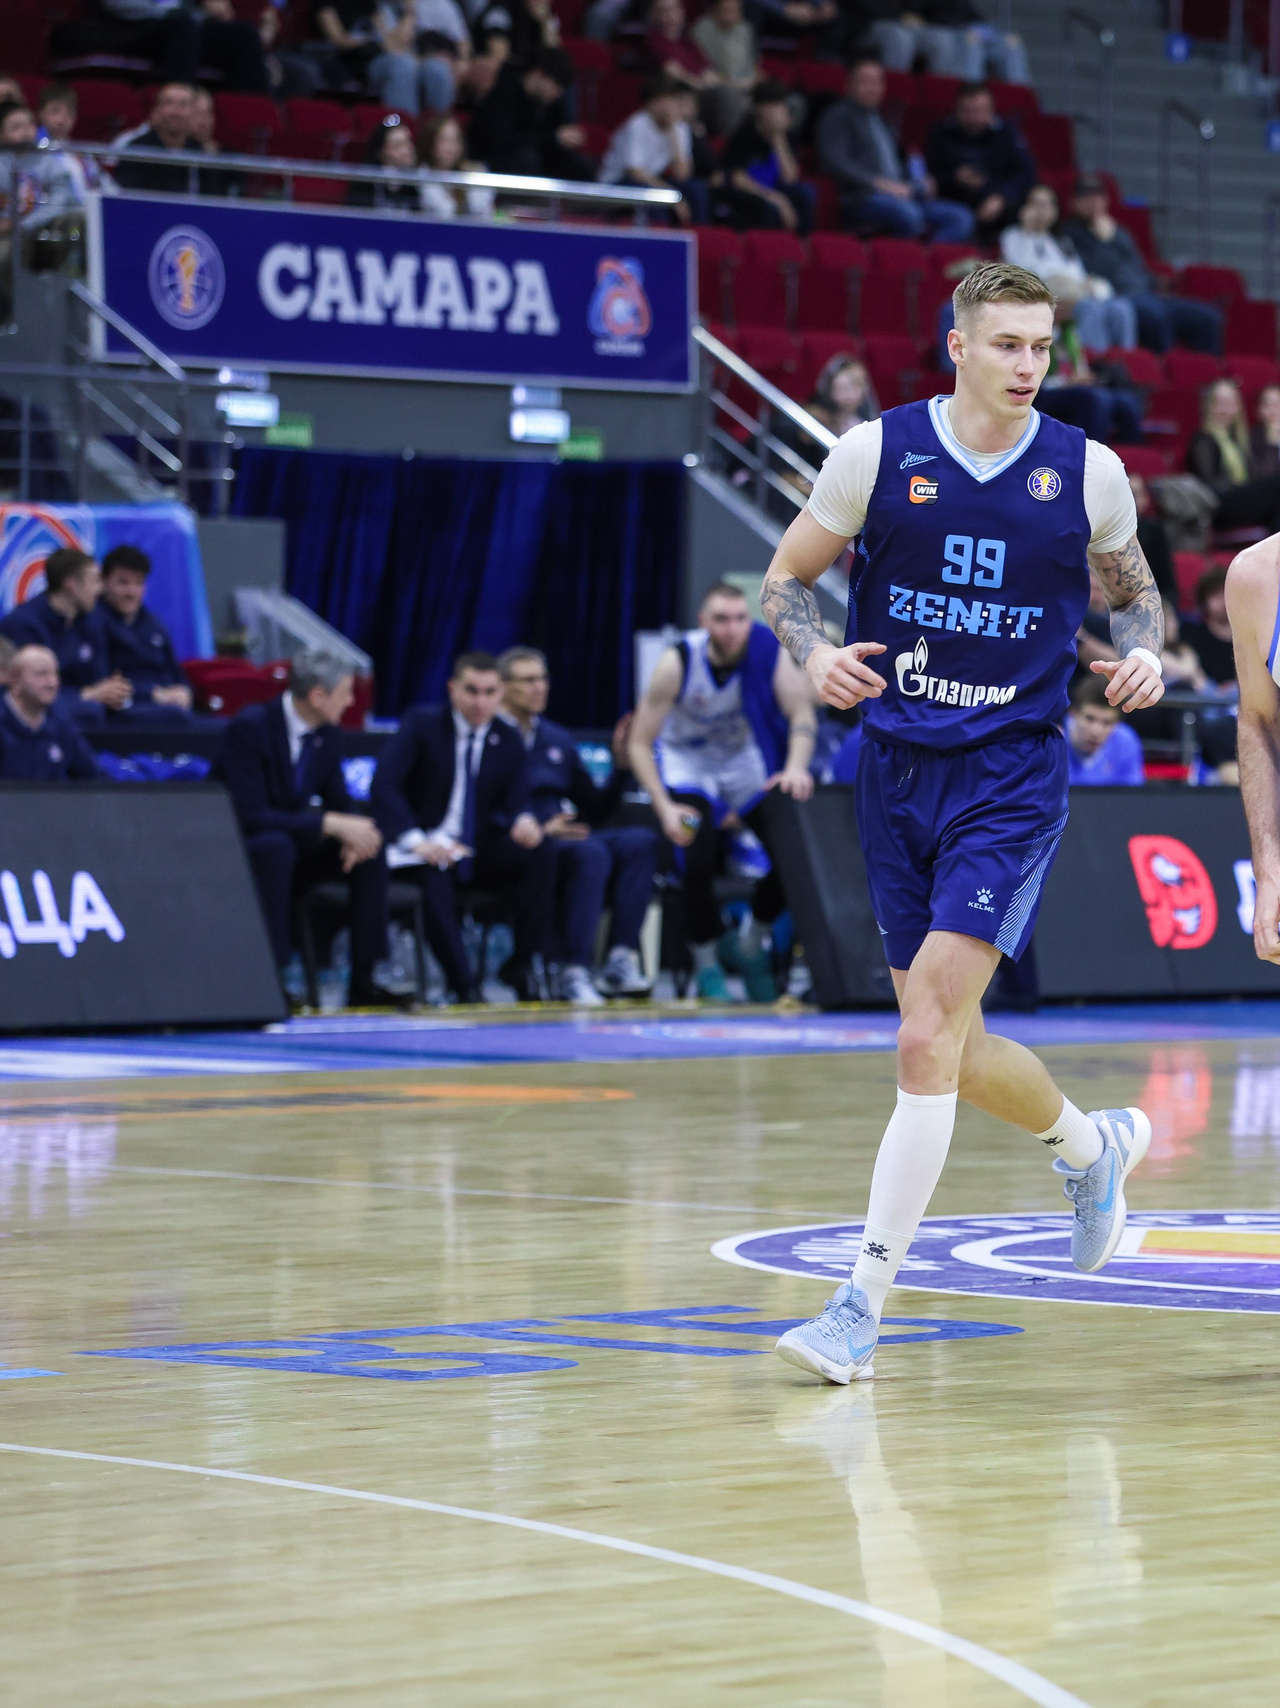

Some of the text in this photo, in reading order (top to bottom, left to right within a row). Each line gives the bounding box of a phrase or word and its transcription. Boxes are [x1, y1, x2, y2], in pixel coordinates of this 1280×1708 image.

[257, 241, 560, 337] САМАРА
[916, 485, 938, 496] WIN
[941, 534, 1007, 589] 99
[888, 584, 1044, 639] ZENIT
[0, 869, 126, 959] ЦА
[967, 900, 996, 914] KELME
[862, 1248, 889, 1263] KELME
[73, 1304, 1026, 1382] ВТБ
